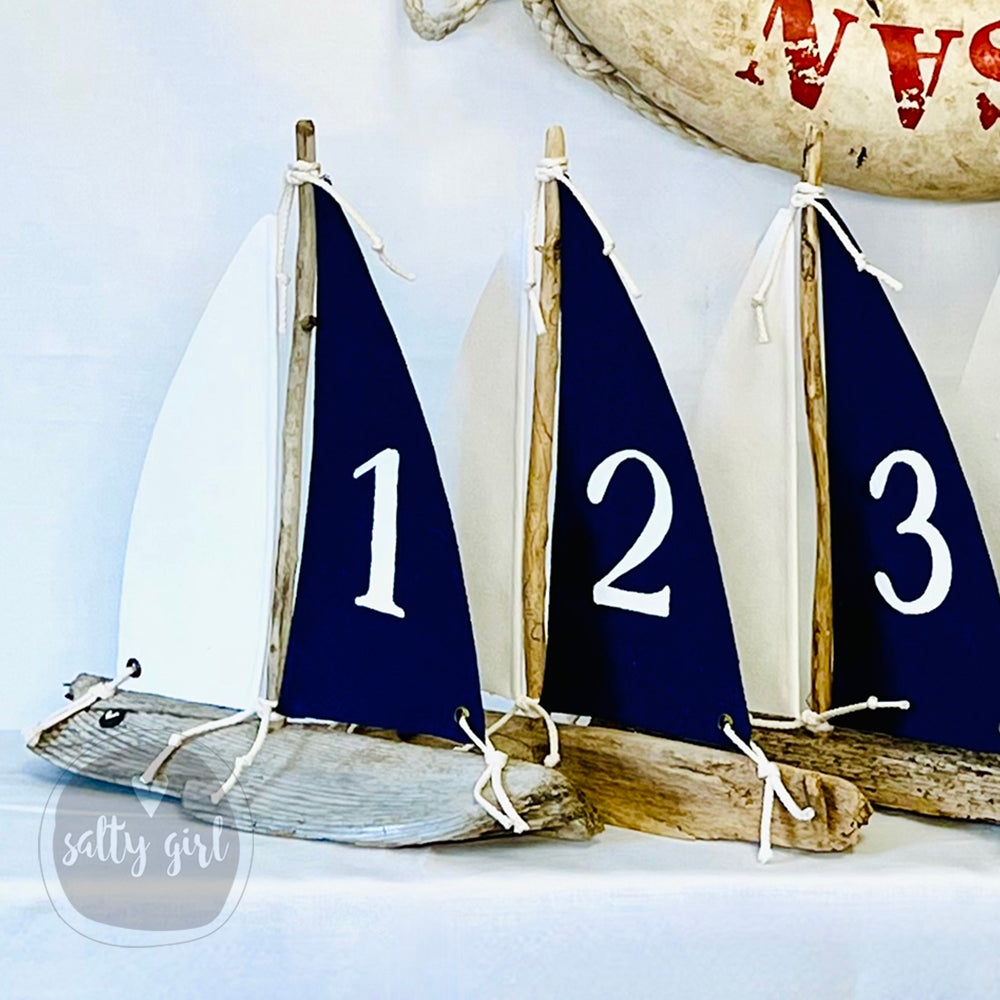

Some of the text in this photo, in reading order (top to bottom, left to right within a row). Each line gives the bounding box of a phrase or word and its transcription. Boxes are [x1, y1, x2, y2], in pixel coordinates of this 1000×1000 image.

[352, 447, 406, 619] 1
[586, 448, 674, 618] 2
[868, 449, 954, 616] 3
